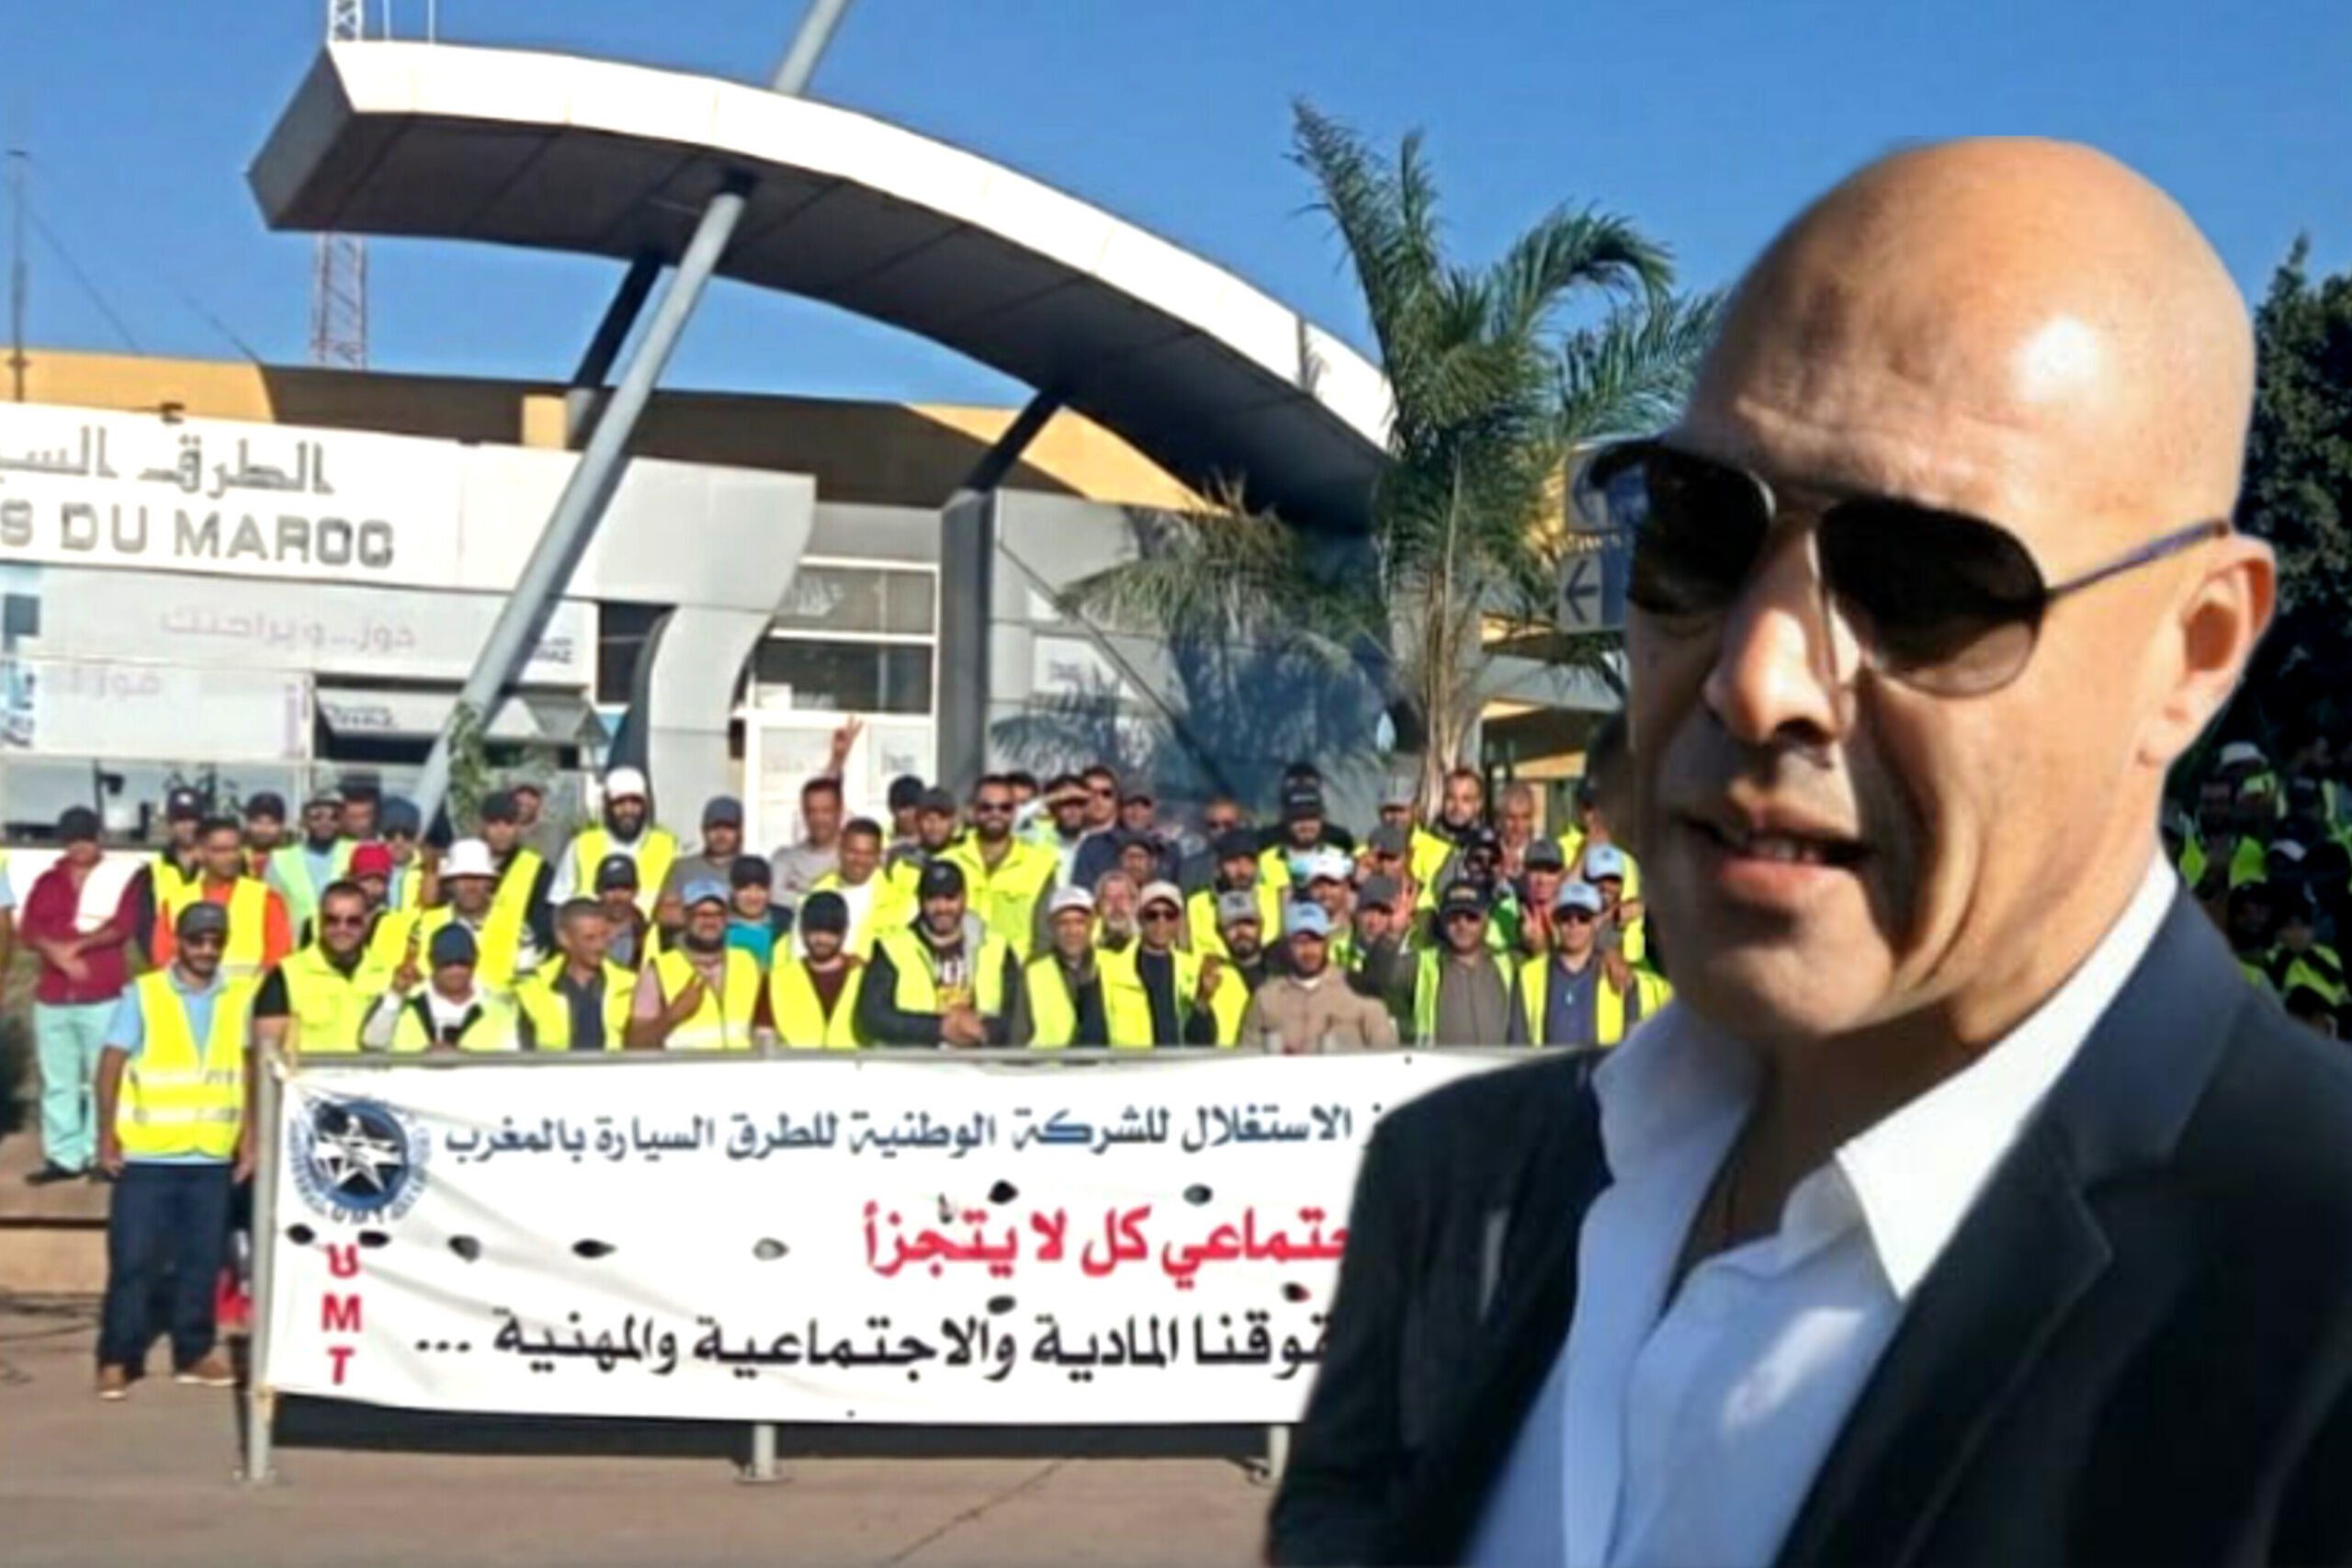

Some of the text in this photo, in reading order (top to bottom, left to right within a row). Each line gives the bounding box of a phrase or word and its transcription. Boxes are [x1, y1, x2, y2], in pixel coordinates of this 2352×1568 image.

[61, 502, 148, 554] DU
[174, 509, 395, 569] MAROC
[446, 1117, 585, 1163] بالمغرب
[596, 1116, 714, 1161] السيارة
[727, 1113, 838, 1160] للطرق
[850, 1111, 996, 1159] الوطنية
[1013, 1107, 1170, 1156] للشركة
[1181, 1104, 1352, 1154] الاستغلال
[865, 1200, 1018, 1278] يتجزأ
[1030, 1210, 1067, 1261] لا
[1080, 1206, 1151, 1277] كل
[493, 1309, 677, 1375] والمهنية
[693, 1317, 1015, 1382] والاجتماعية
[1032, 1315, 1179, 1382] المادية
